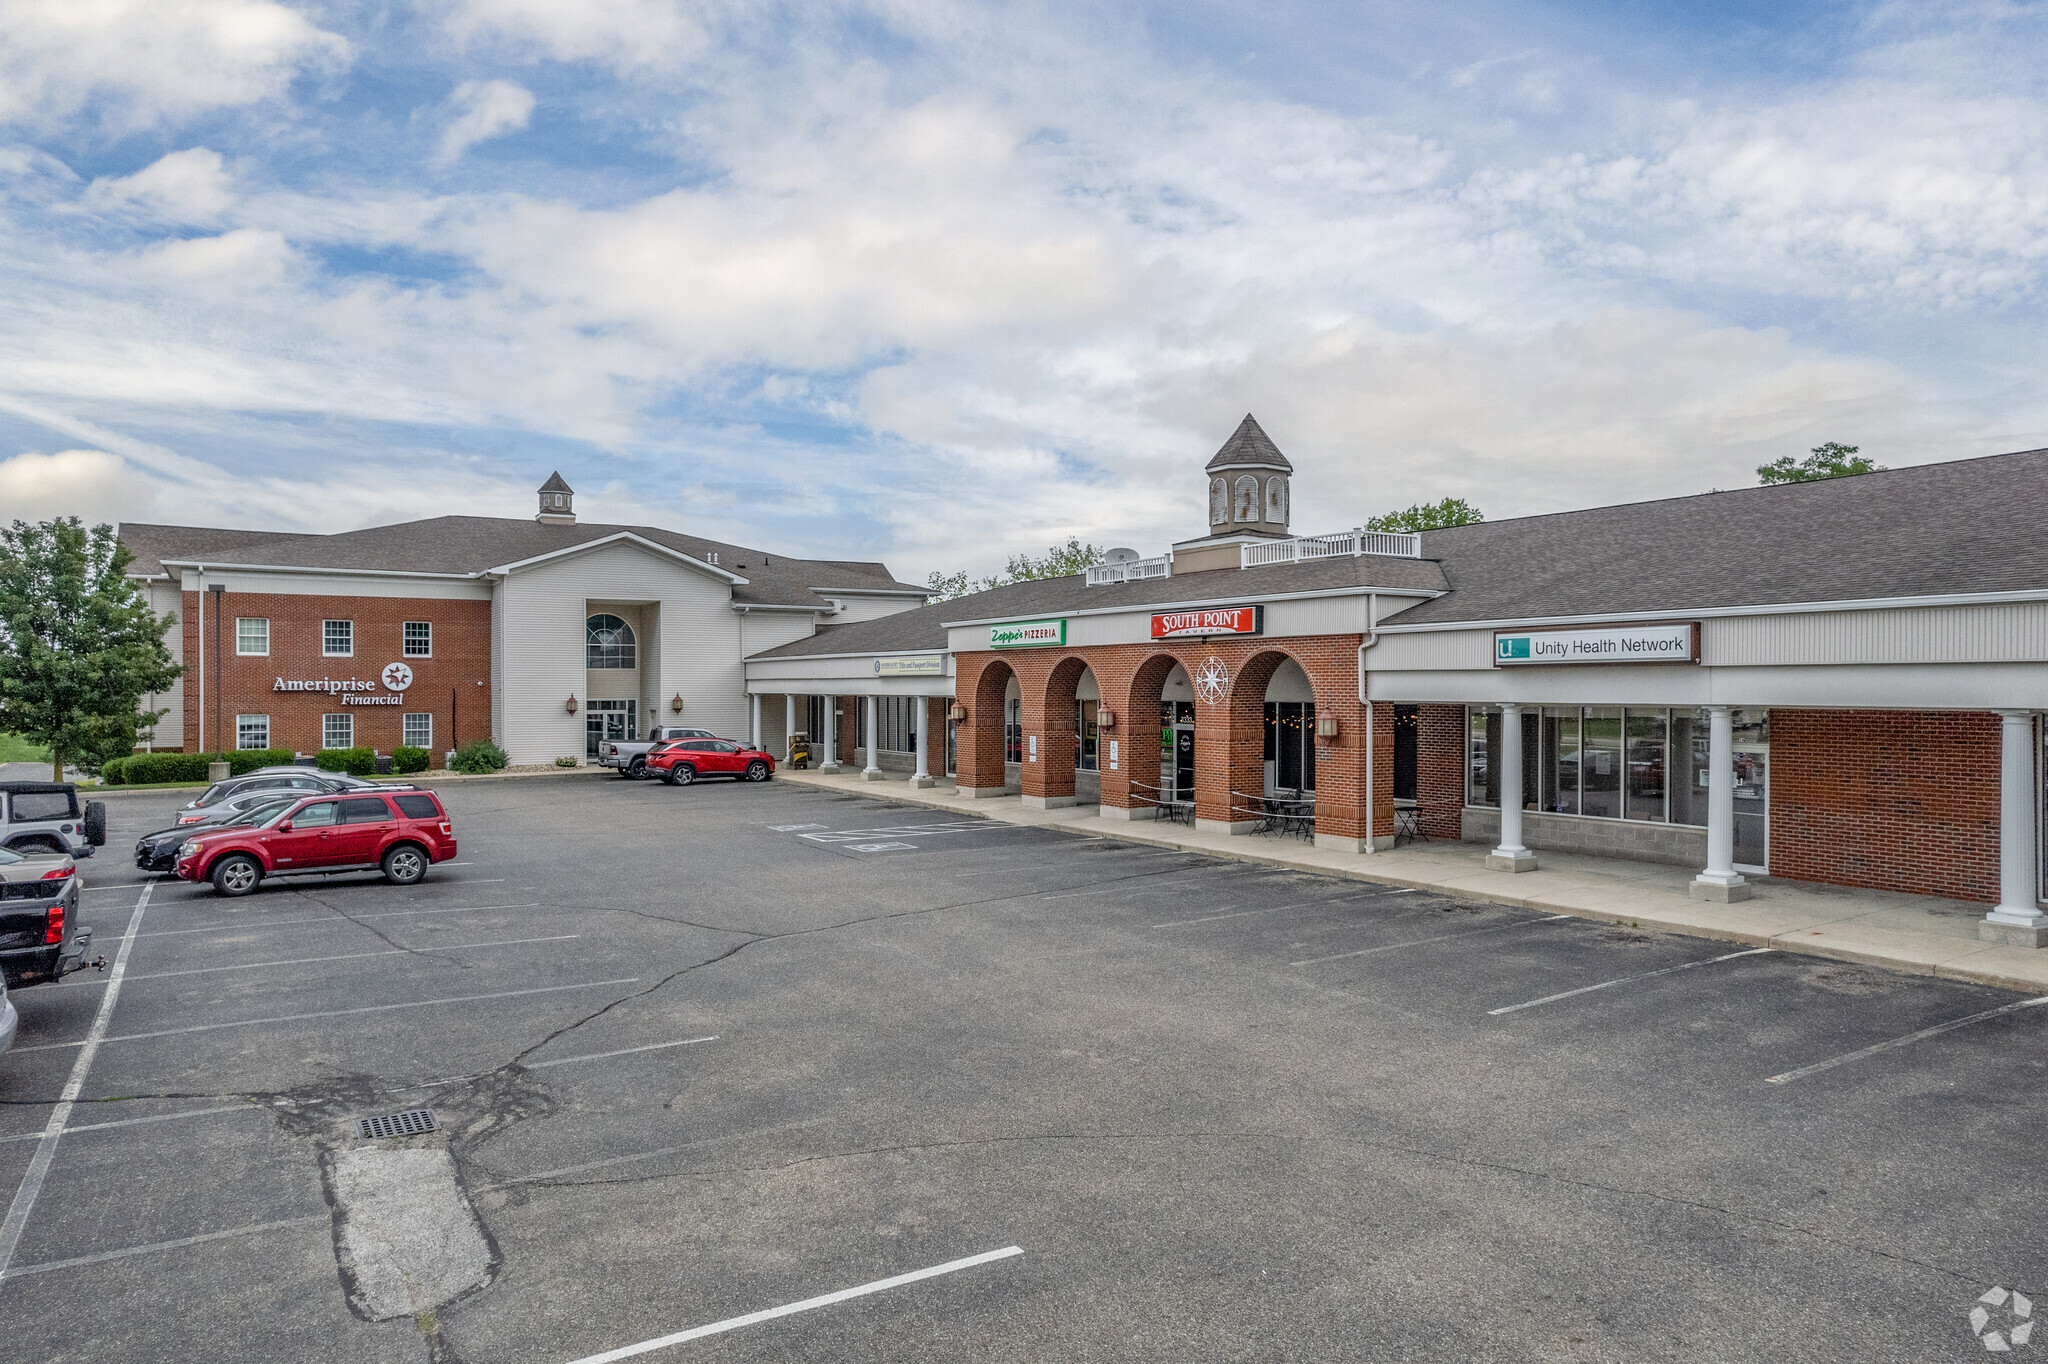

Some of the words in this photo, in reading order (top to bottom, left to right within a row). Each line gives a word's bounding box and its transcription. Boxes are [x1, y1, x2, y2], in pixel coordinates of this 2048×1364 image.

[1162, 613, 1199, 632] SOUTH
[1204, 610, 1241, 628] POINT
[1024, 628, 1057, 639] PIZZERIA
[1535, 641, 1569, 658] Unity
[1573, 639, 1616, 654] Health
[1621, 636, 1684, 652] Network
[913, 660, 926, 670] Passport
[927, 660, 940, 668] Division
[273, 676, 376, 696] Ameriprise
[341, 693, 404, 706] Financial
